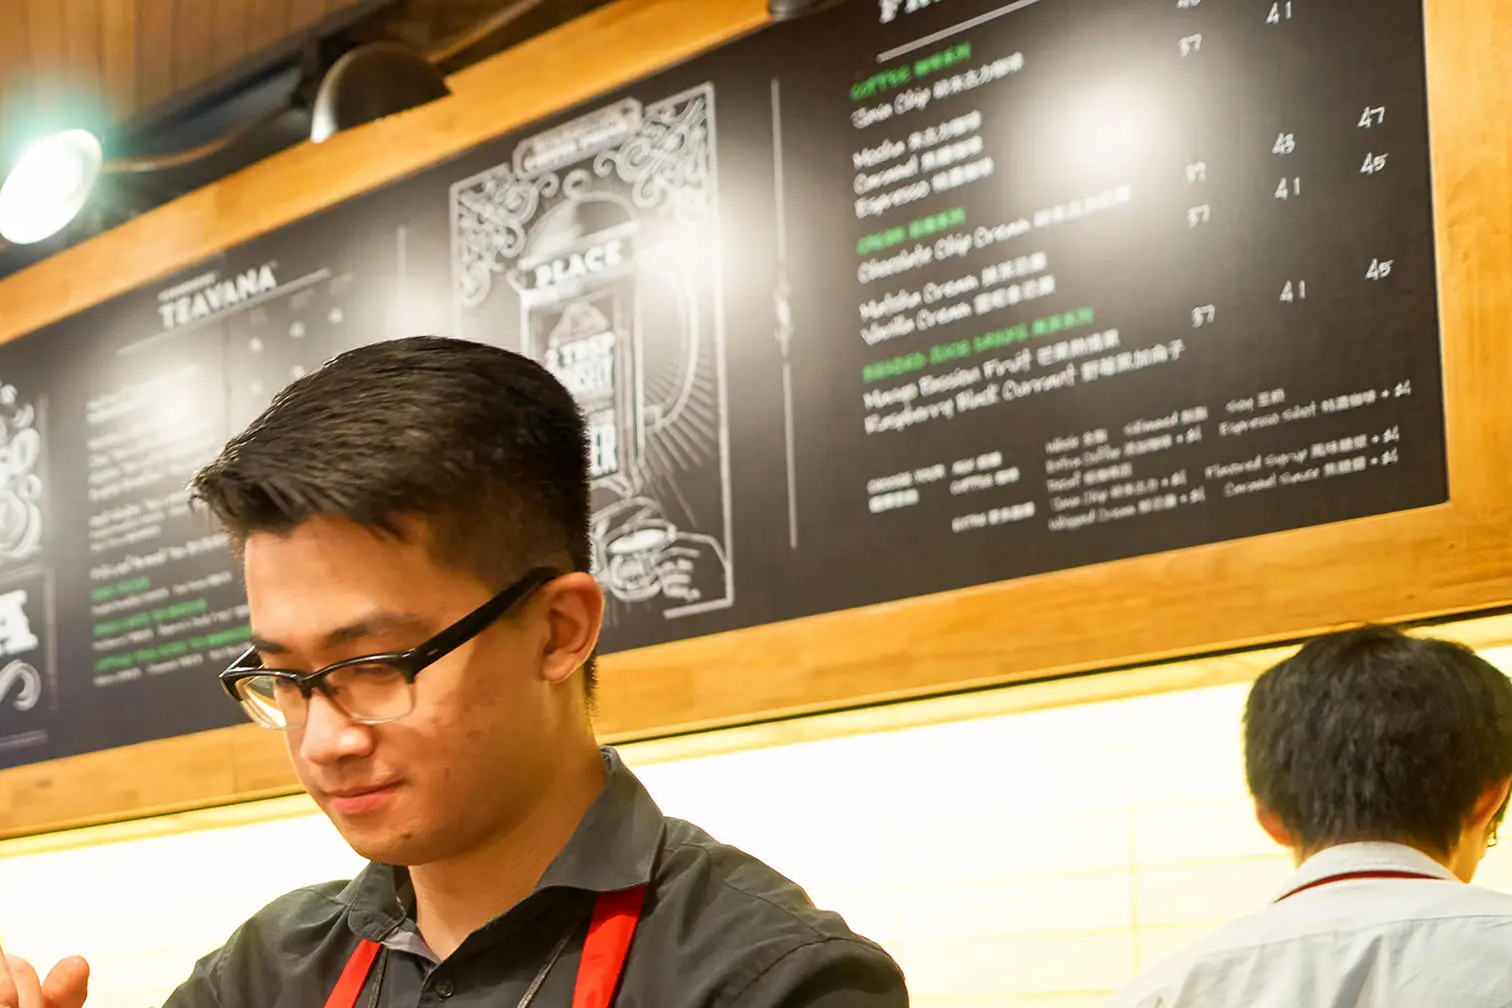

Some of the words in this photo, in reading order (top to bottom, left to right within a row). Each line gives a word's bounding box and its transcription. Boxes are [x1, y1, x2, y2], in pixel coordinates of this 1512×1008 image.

[1265, 1, 1292, 24] 41
[1357, 106, 1385, 128] 47
[1359, 152, 1388, 175] 45
[1274, 177, 1300, 200] 41
[1364, 258, 1394, 280] 45
[158, 263, 277, 329] TEAVANA
[1279, 279, 1306, 303] 41
[983, 348, 1032, 377] Fruit
